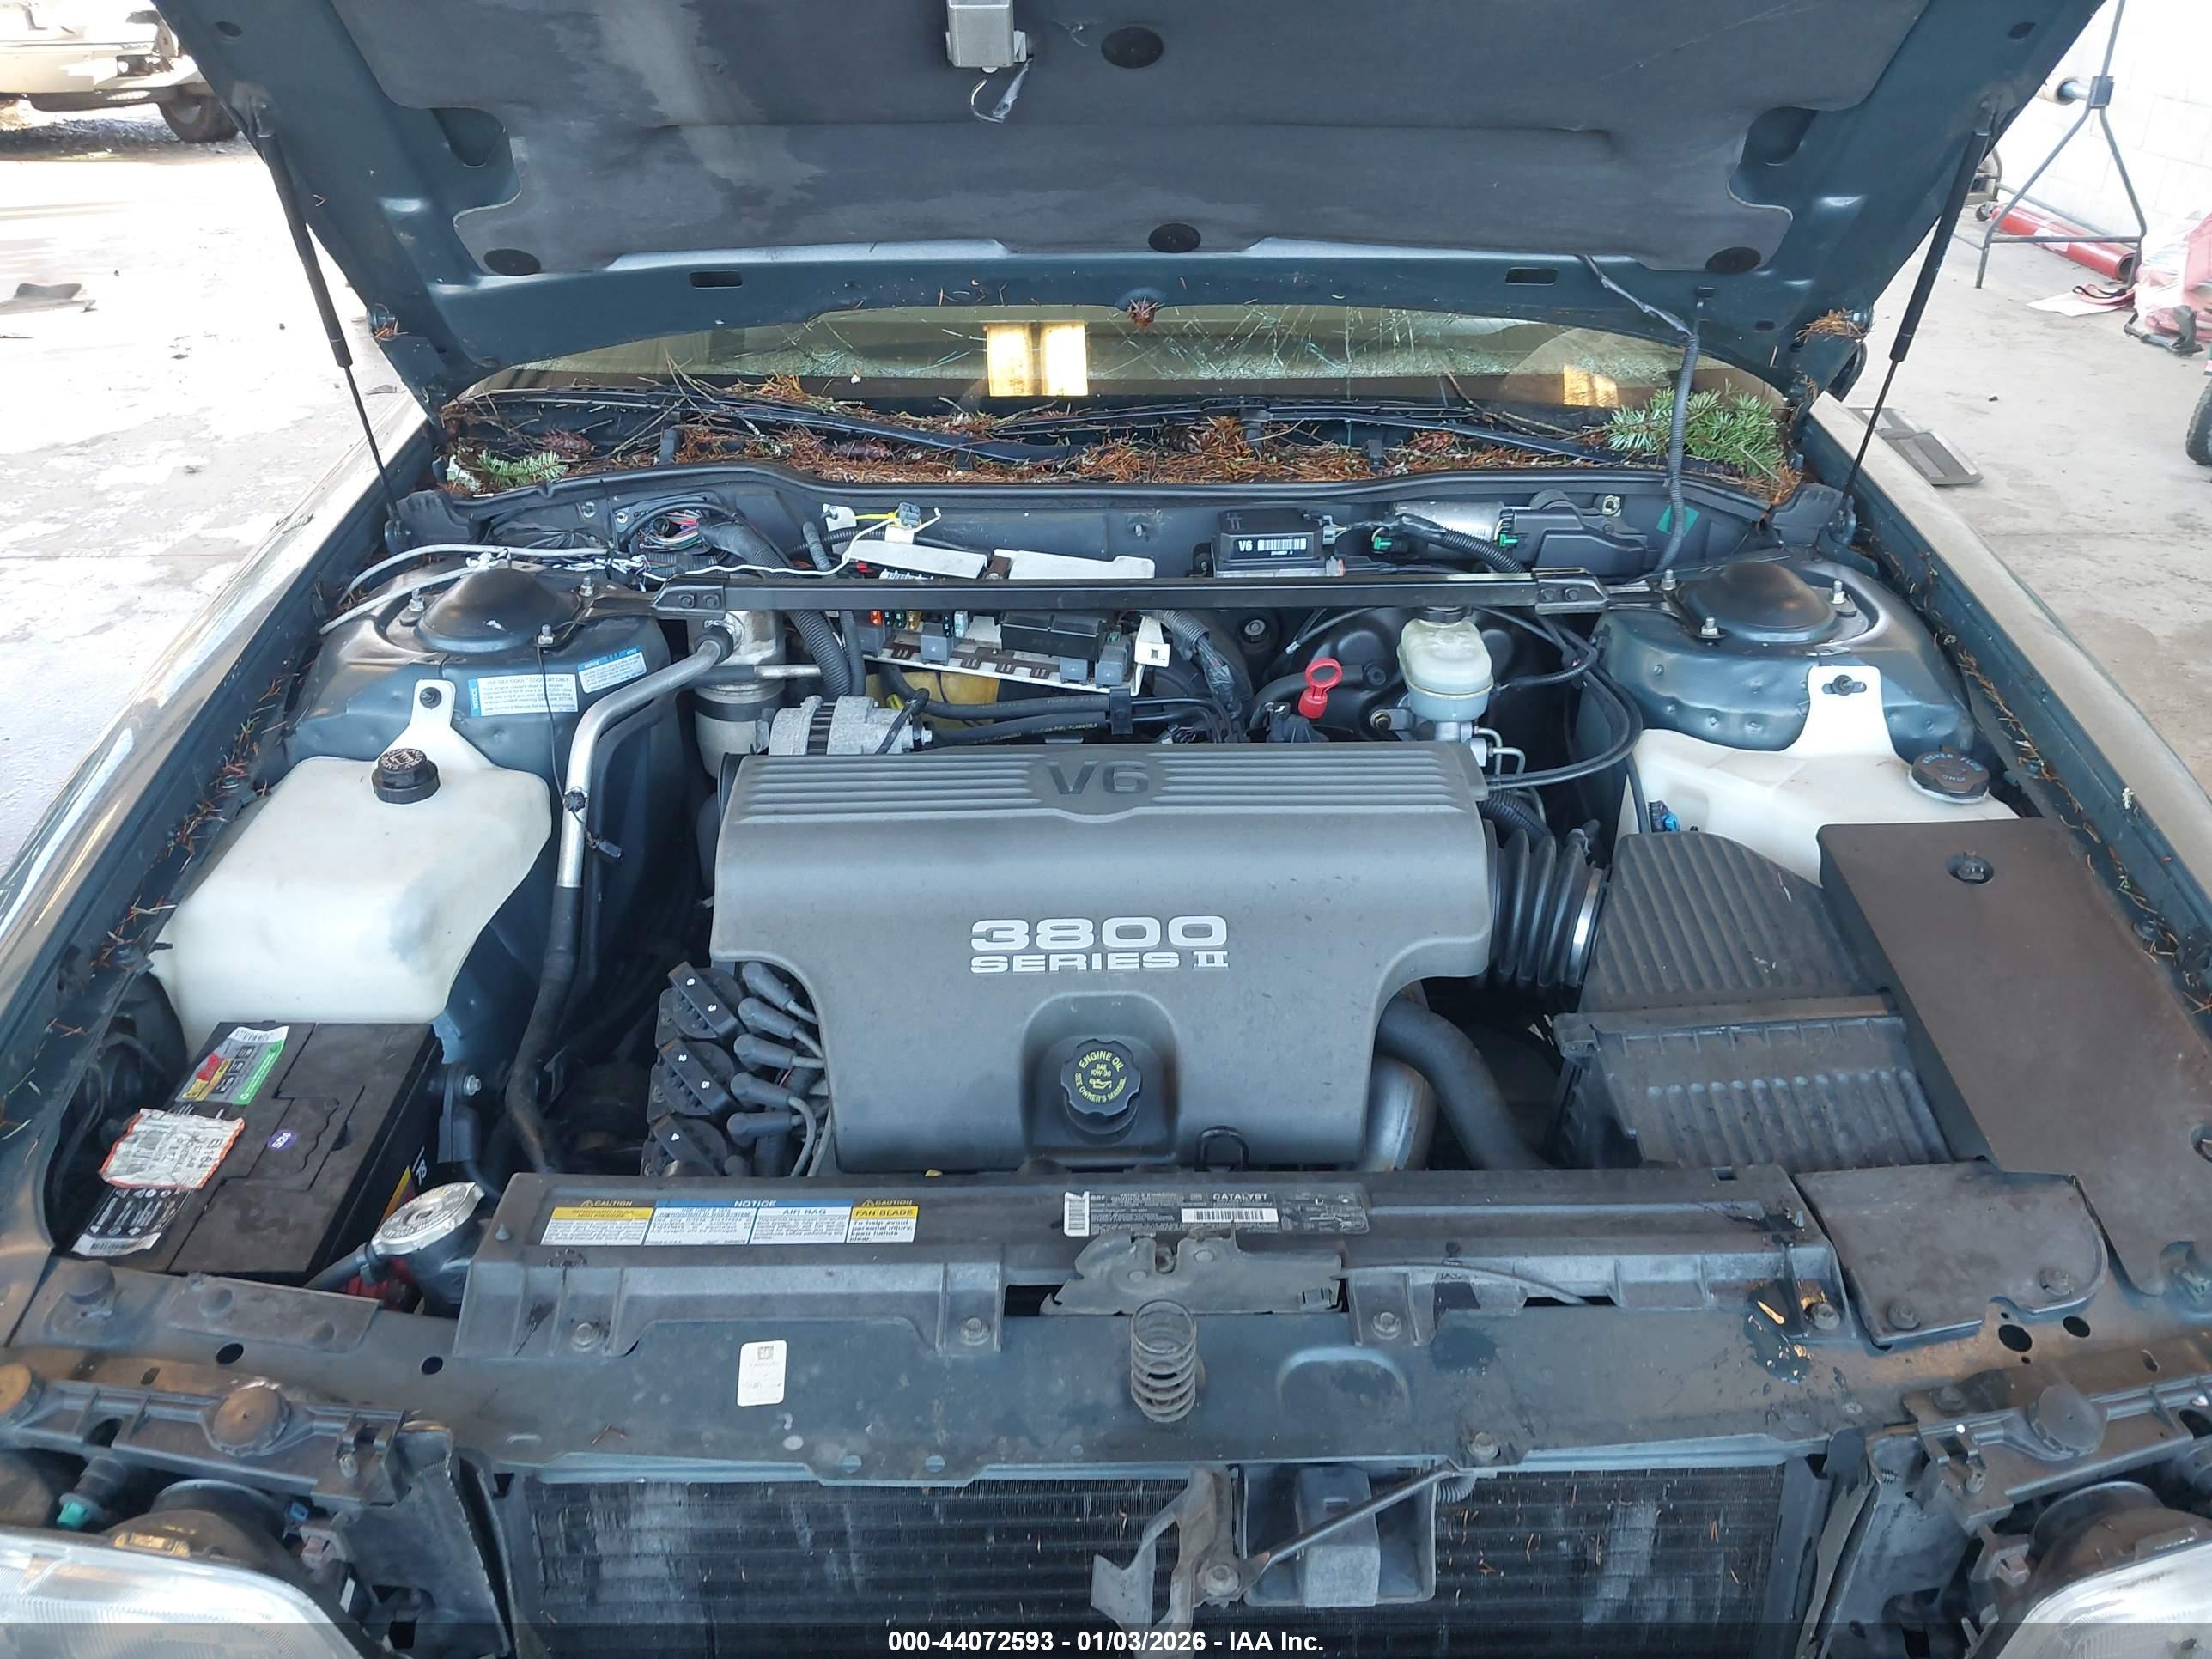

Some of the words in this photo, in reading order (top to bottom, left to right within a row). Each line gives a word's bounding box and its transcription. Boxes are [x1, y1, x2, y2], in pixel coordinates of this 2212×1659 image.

[1238, 540, 1253, 551] V6
[1045, 760, 1150, 795] V6
[970, 915, 1228, 951] 3800
[970, 951, 1181, 974] SERIES
[1193, 951, 1230, 969] II
[1079, 1051, 1113, 1069] ENGINE
[1112, 1057, 1124, 1072] OIL
[1079, 1086, 1107, 1103] OWNER'S
[733, 1200, 776, 1208] NOTICE
